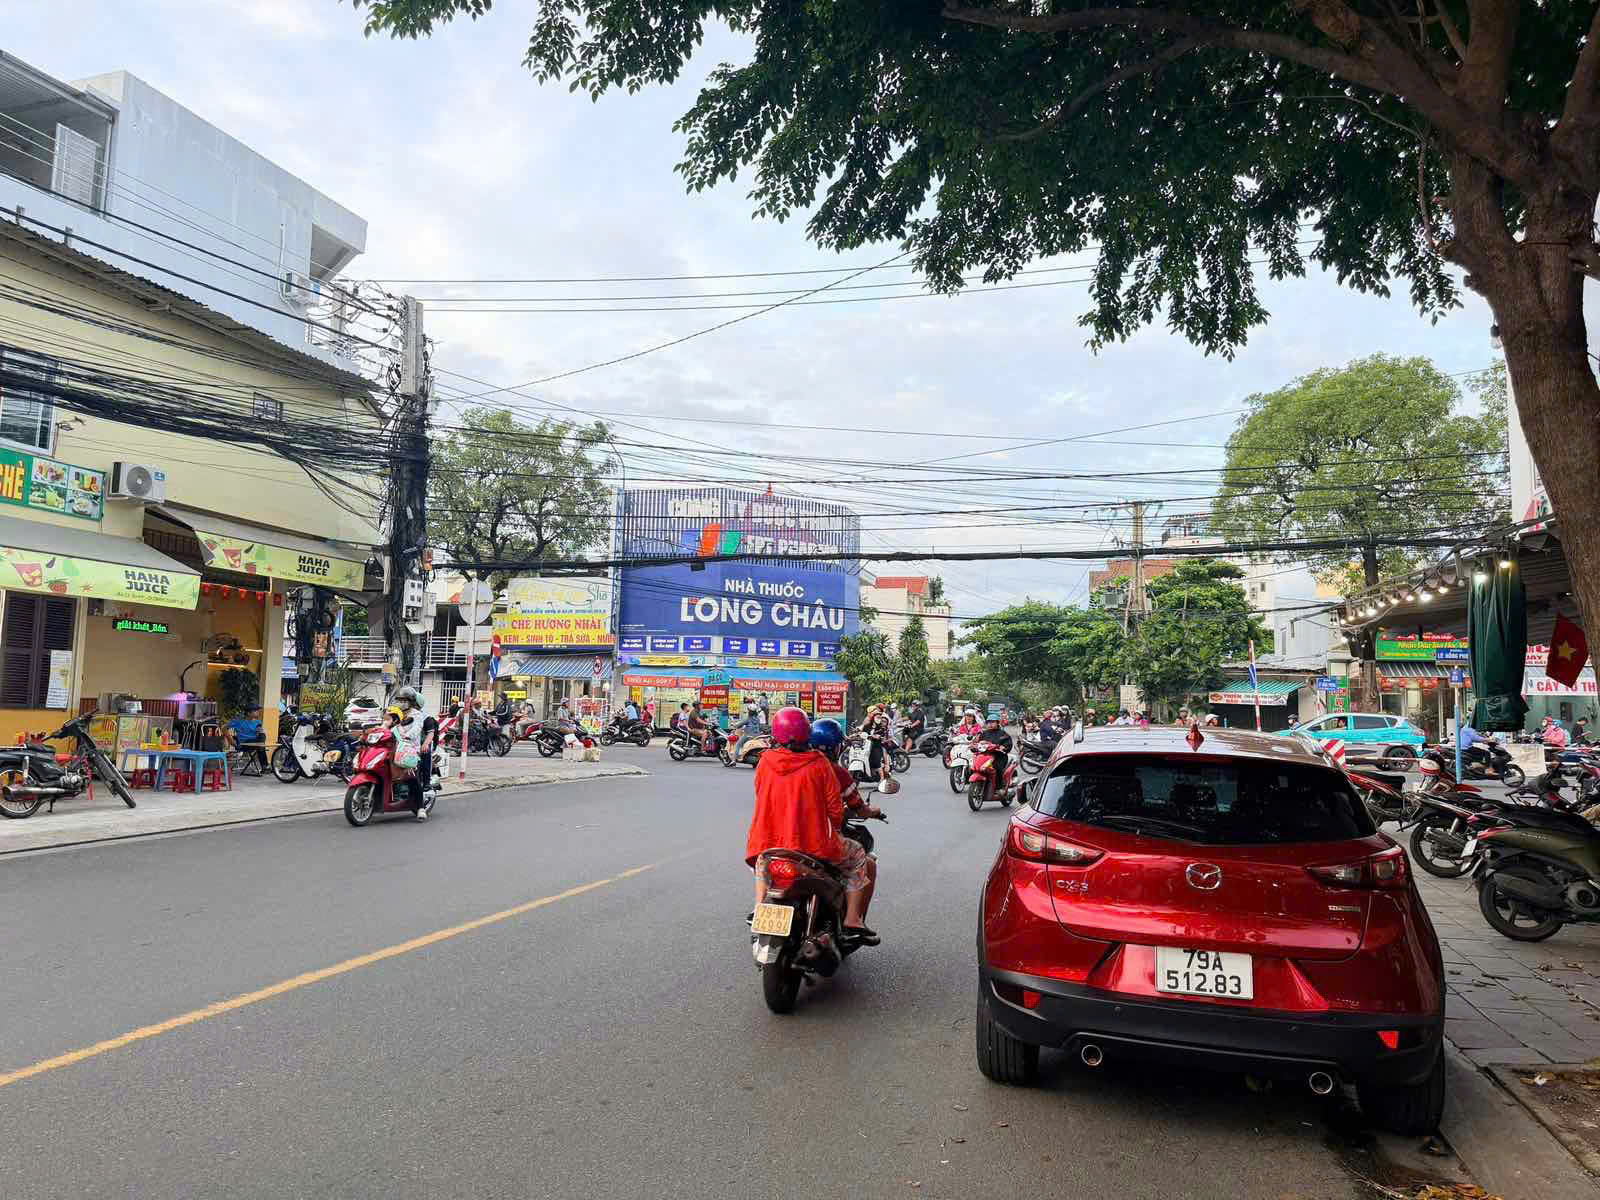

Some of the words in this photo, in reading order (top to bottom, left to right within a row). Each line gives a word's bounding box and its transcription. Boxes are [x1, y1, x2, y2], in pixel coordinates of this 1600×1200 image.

[296, 564, 328, 576] JUICE
[298, 555, 330, 568] HAHA
[124, 570, 170, 584] HAHA
[126, 581, 168, 595] JUICE
[725, 578, 755, 594] NHÀ
[758, 580, 805, 598] THUỐC
[680, 597, 763, 625] LONG
[771, 598, 845, 630] CHÂU
[1183, 948, 1223, 971] 79A
[1166, 970, 1241, 995] 512.83
